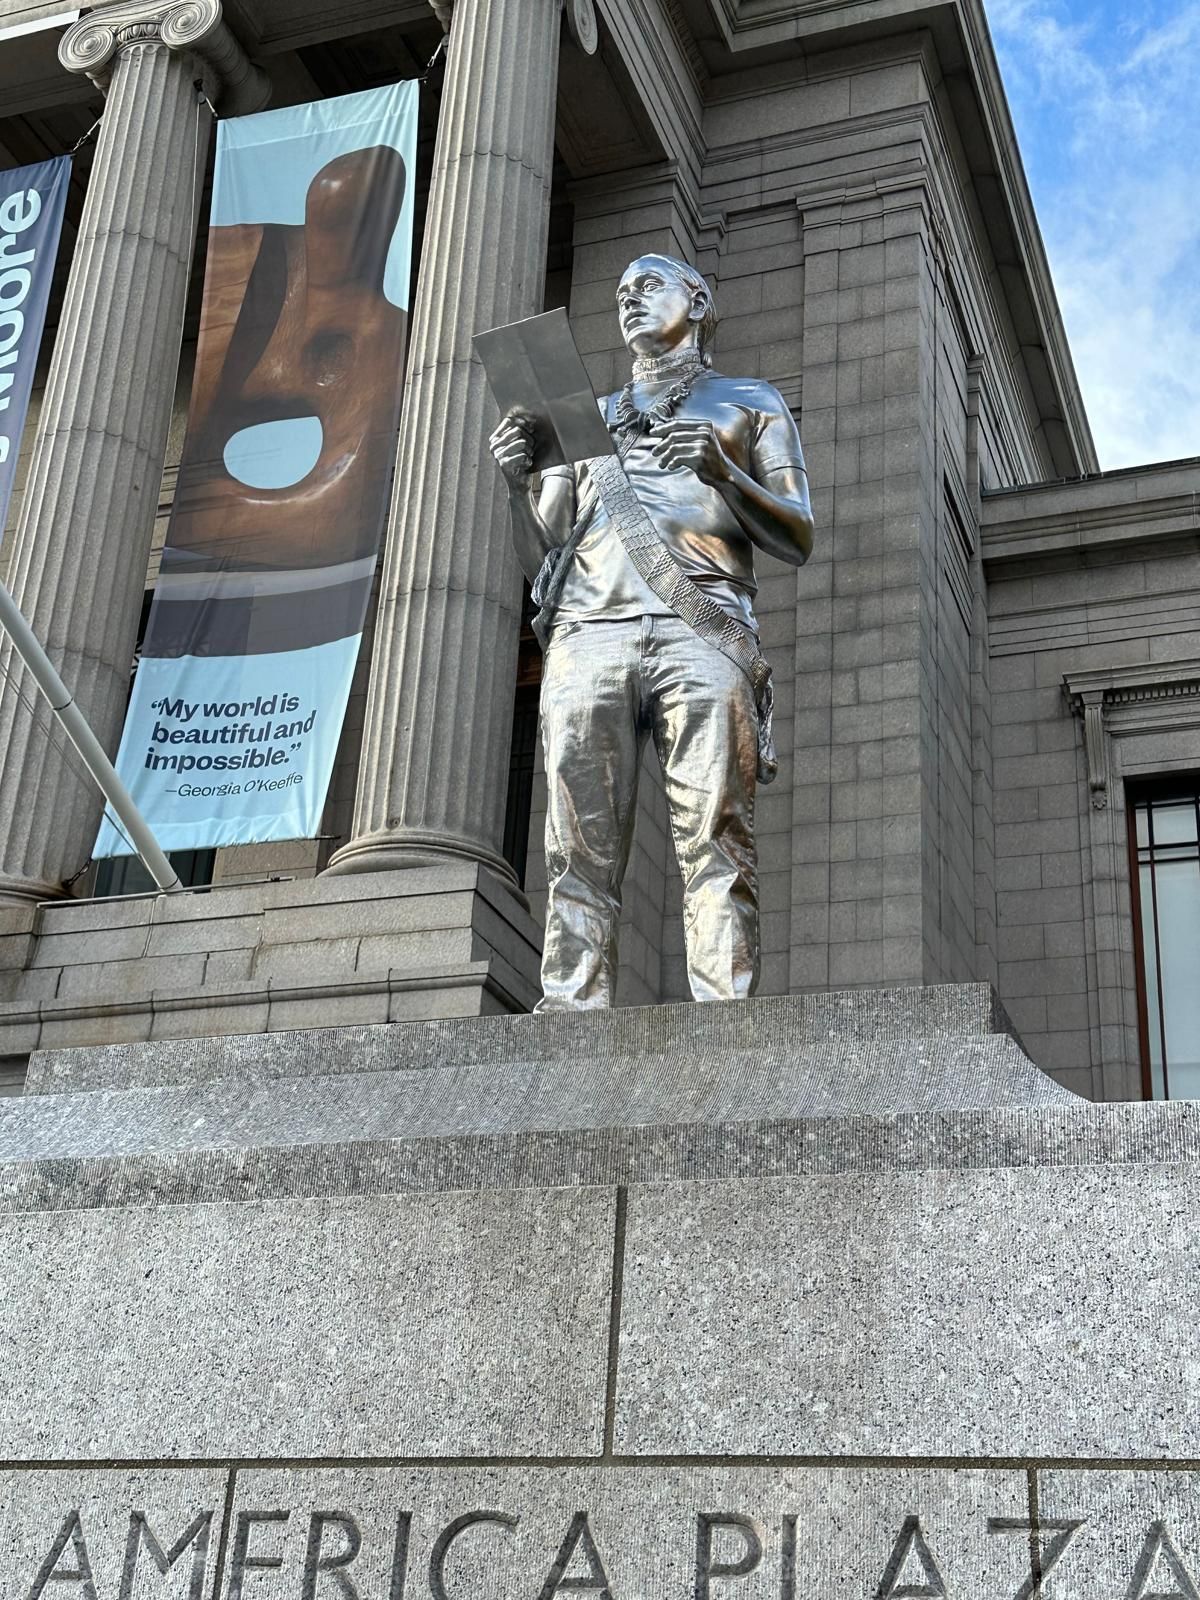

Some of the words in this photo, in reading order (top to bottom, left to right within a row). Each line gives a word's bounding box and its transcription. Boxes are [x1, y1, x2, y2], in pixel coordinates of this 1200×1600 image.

[151, 697, 200, 723] “My
[203, 694, 278, 718] world
[280, 692, 300, 712] is
[151, 721, 271, 744] beautiful
[273, 710, 317, 739] and
[144, 742, 302, 774] impossible.”
[25, 1509, 616, 1600] AMERICA
